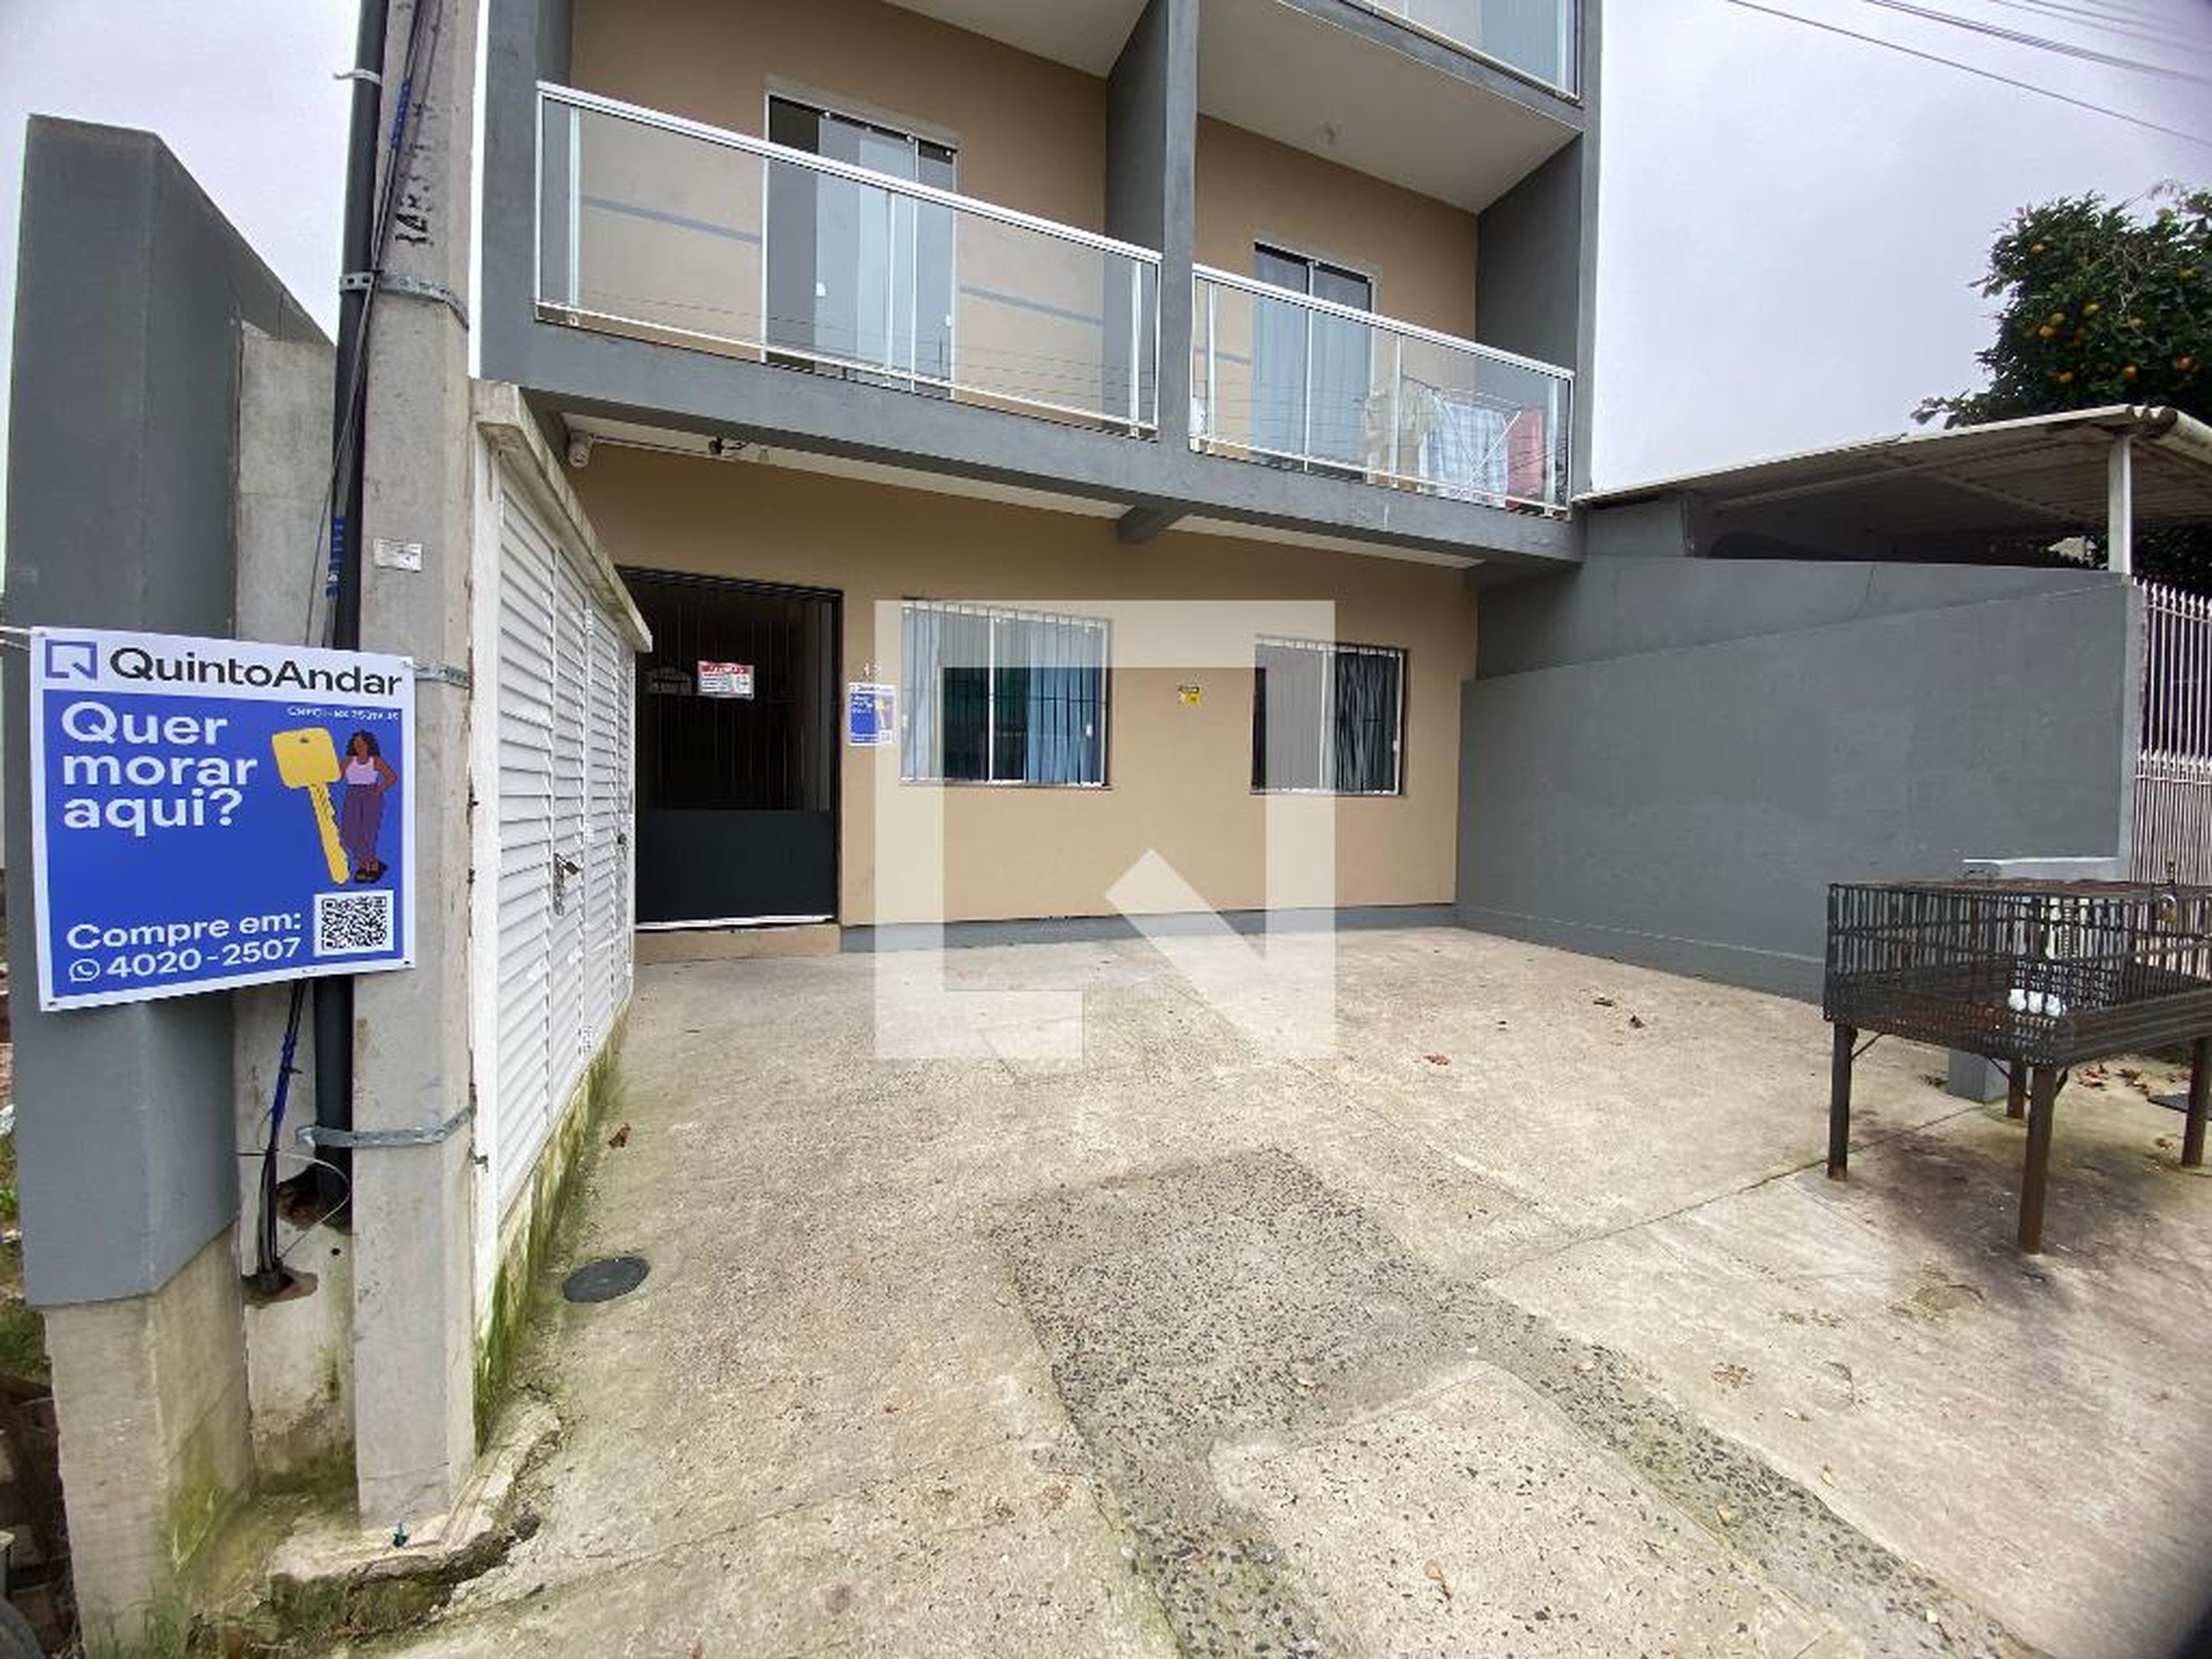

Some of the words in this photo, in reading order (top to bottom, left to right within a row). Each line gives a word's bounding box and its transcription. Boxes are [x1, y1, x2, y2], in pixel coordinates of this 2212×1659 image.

[110, 647, 402, 696] QuintoAndar
[62, 702, 228, 745] Quer
[63, 755, 257, 786] morar
[63, 787, 243, 837] aqui?
[66, 919, 230, 950] Compre
[239, 911, 302, 934] em:
